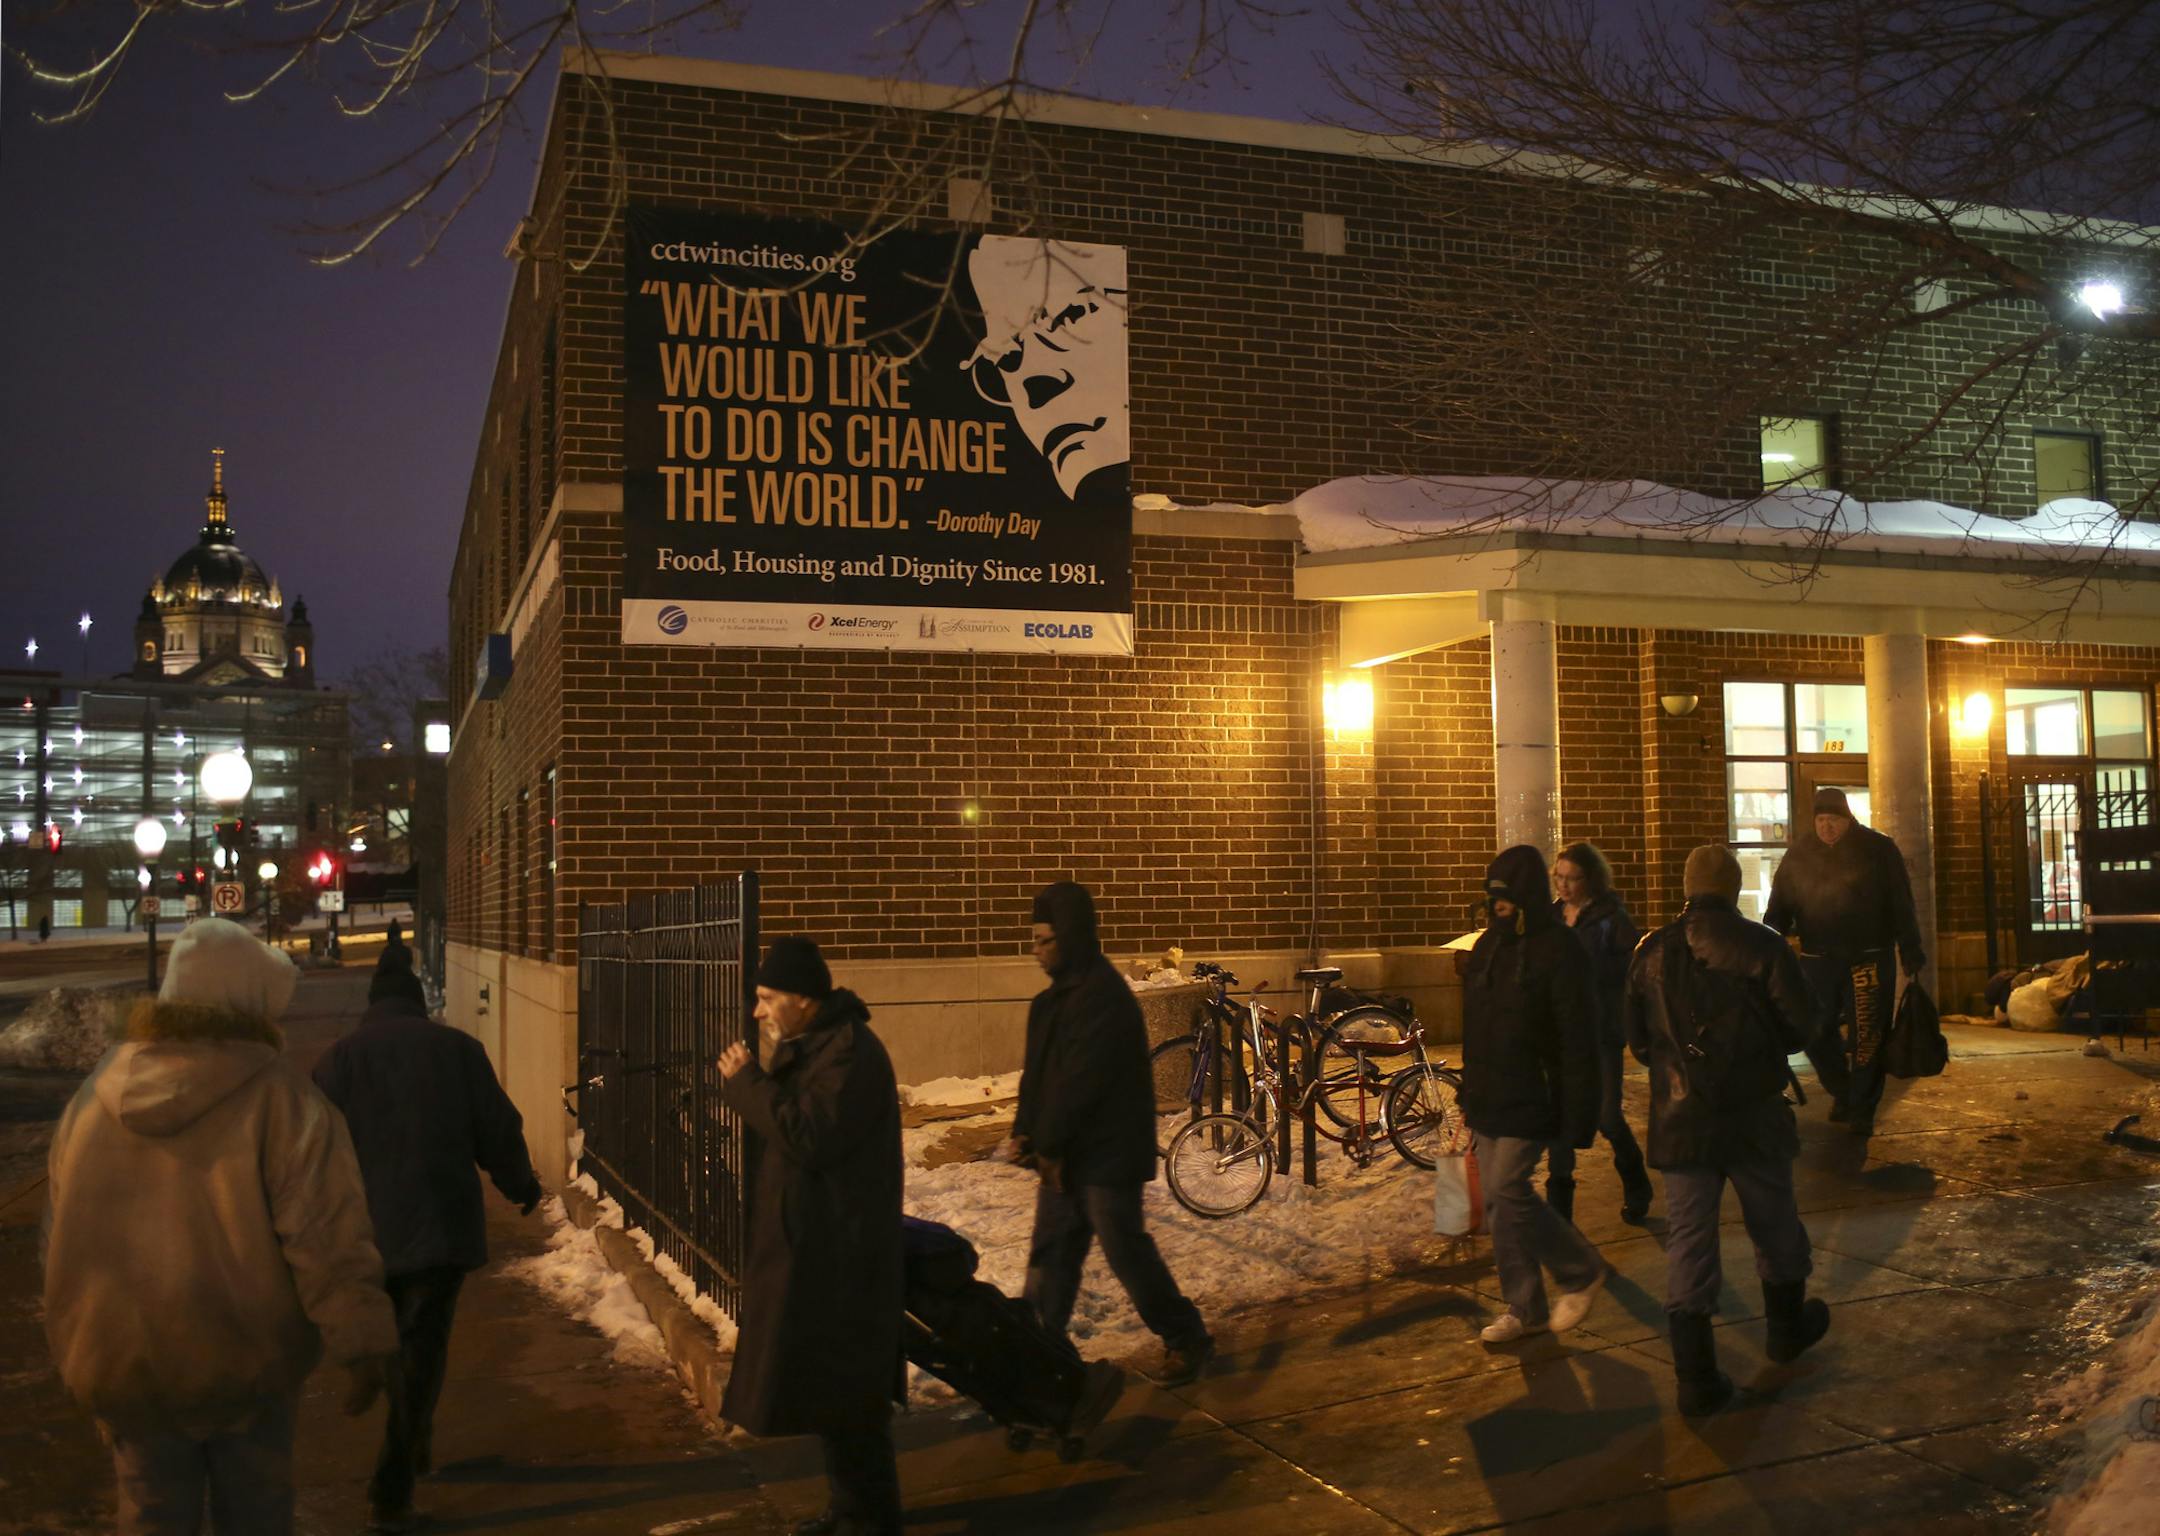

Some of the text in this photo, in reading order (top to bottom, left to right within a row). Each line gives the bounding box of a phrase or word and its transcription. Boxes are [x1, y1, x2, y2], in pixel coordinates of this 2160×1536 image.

[651, 241, 857, 282] cctwincities.org
[640, 280, 867, 347] “WHAT WE
[659, 342, 911, 410] WOULD LIKE
[658, 404, 1007, 474] TO DO IS CHANGE
[658, 466, 924, 530] THE WORLD.”
[1007, 512, 1041, 541] Day
[656, 548, 1105, 586] Food, Housing and Dignity Since 1981.
[1024, 622, 1094, 639] ECOLAB
[1824, 740, 1845, 752] 183
